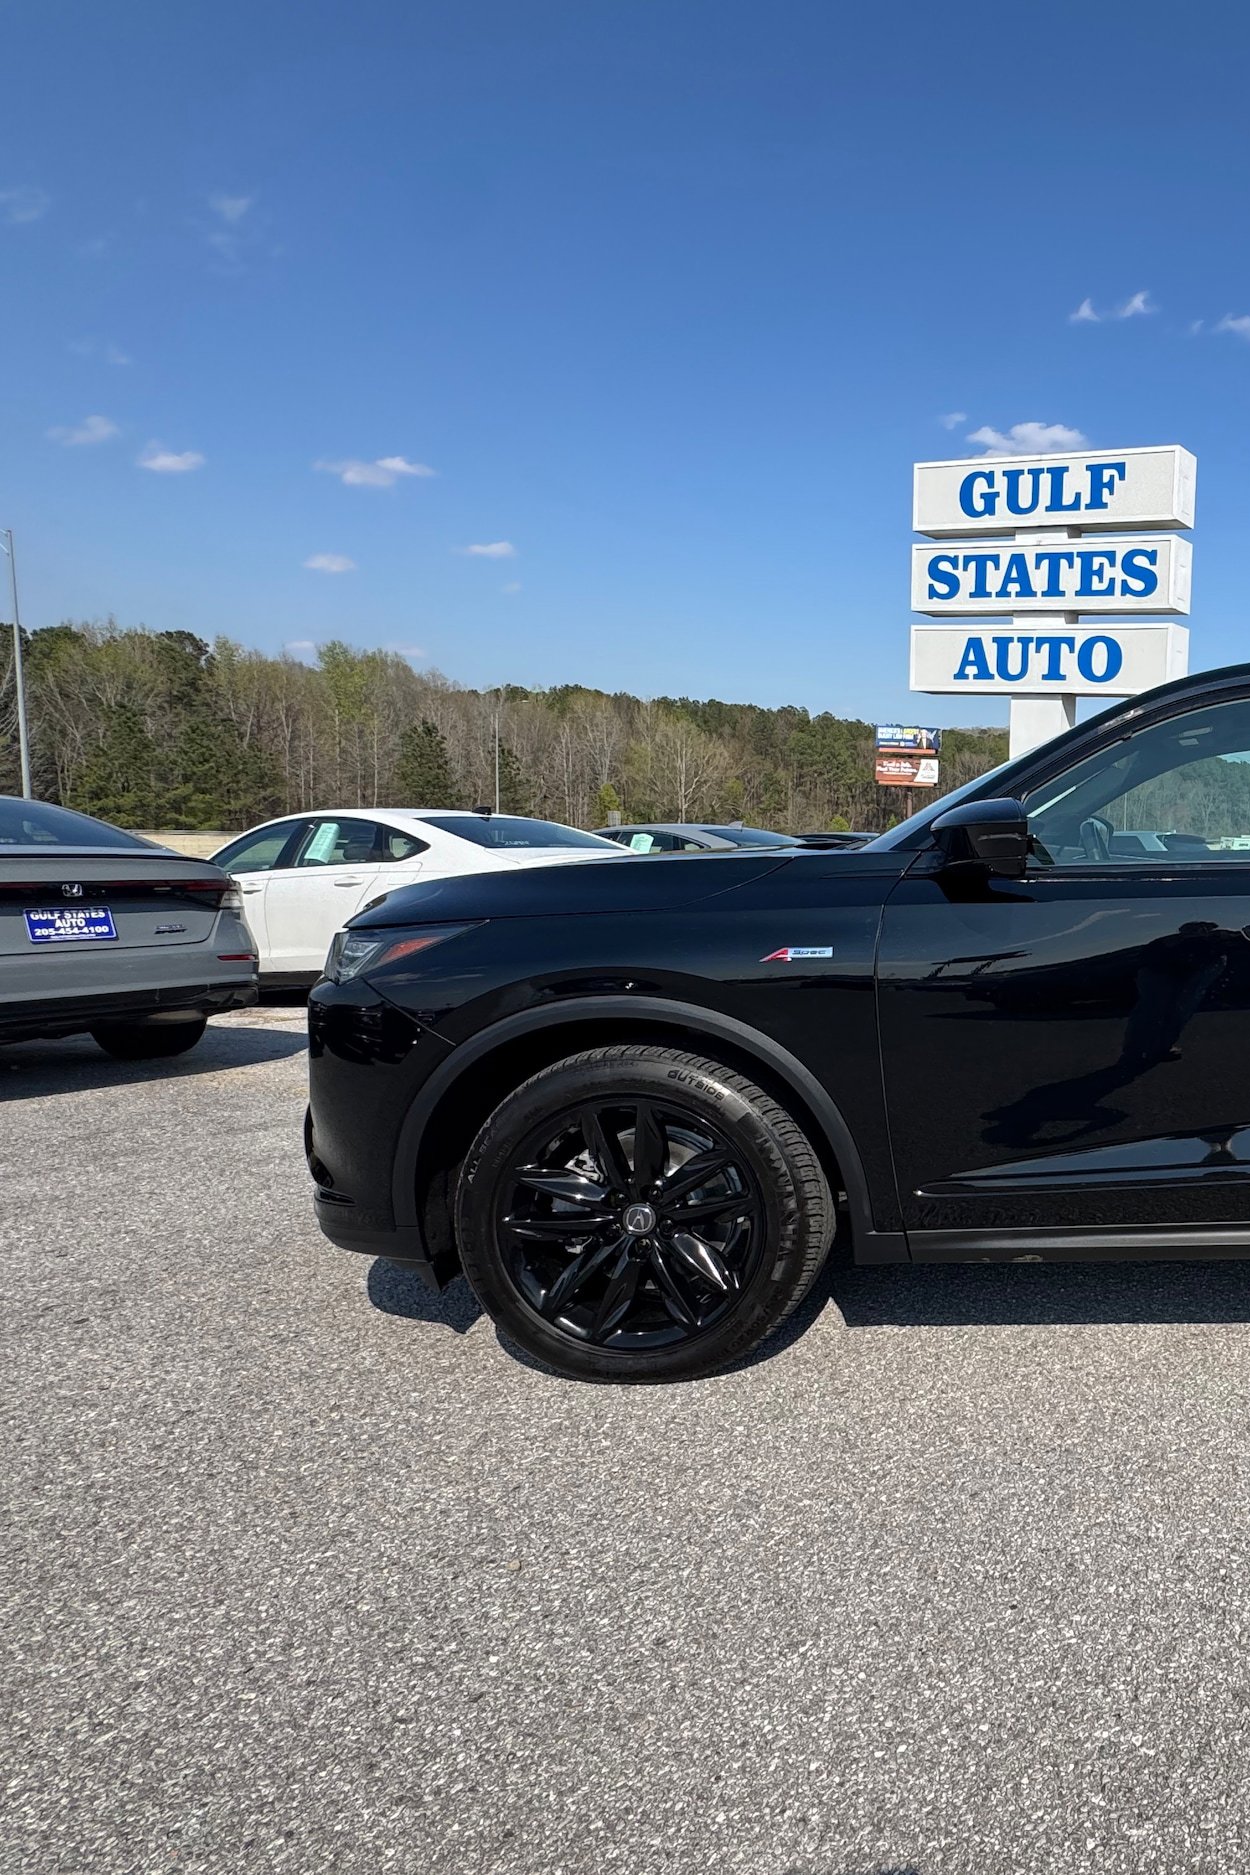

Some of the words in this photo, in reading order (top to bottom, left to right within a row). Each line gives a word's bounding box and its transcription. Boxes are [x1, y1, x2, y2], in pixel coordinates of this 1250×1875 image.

[959, 461, 1126, 519] GULF
[927, 549, 1158, 600] STATES
[953, 635, 1123, 683] AUTO
[30, 911, 61, 920] GULF
[64, 910, 105, 919] STATES
[55, 918, 86, 928] AUTO
[34, 926, 109, 936] 205-454-4100
[667, 1070, 725, 1100] OUTSIDE
